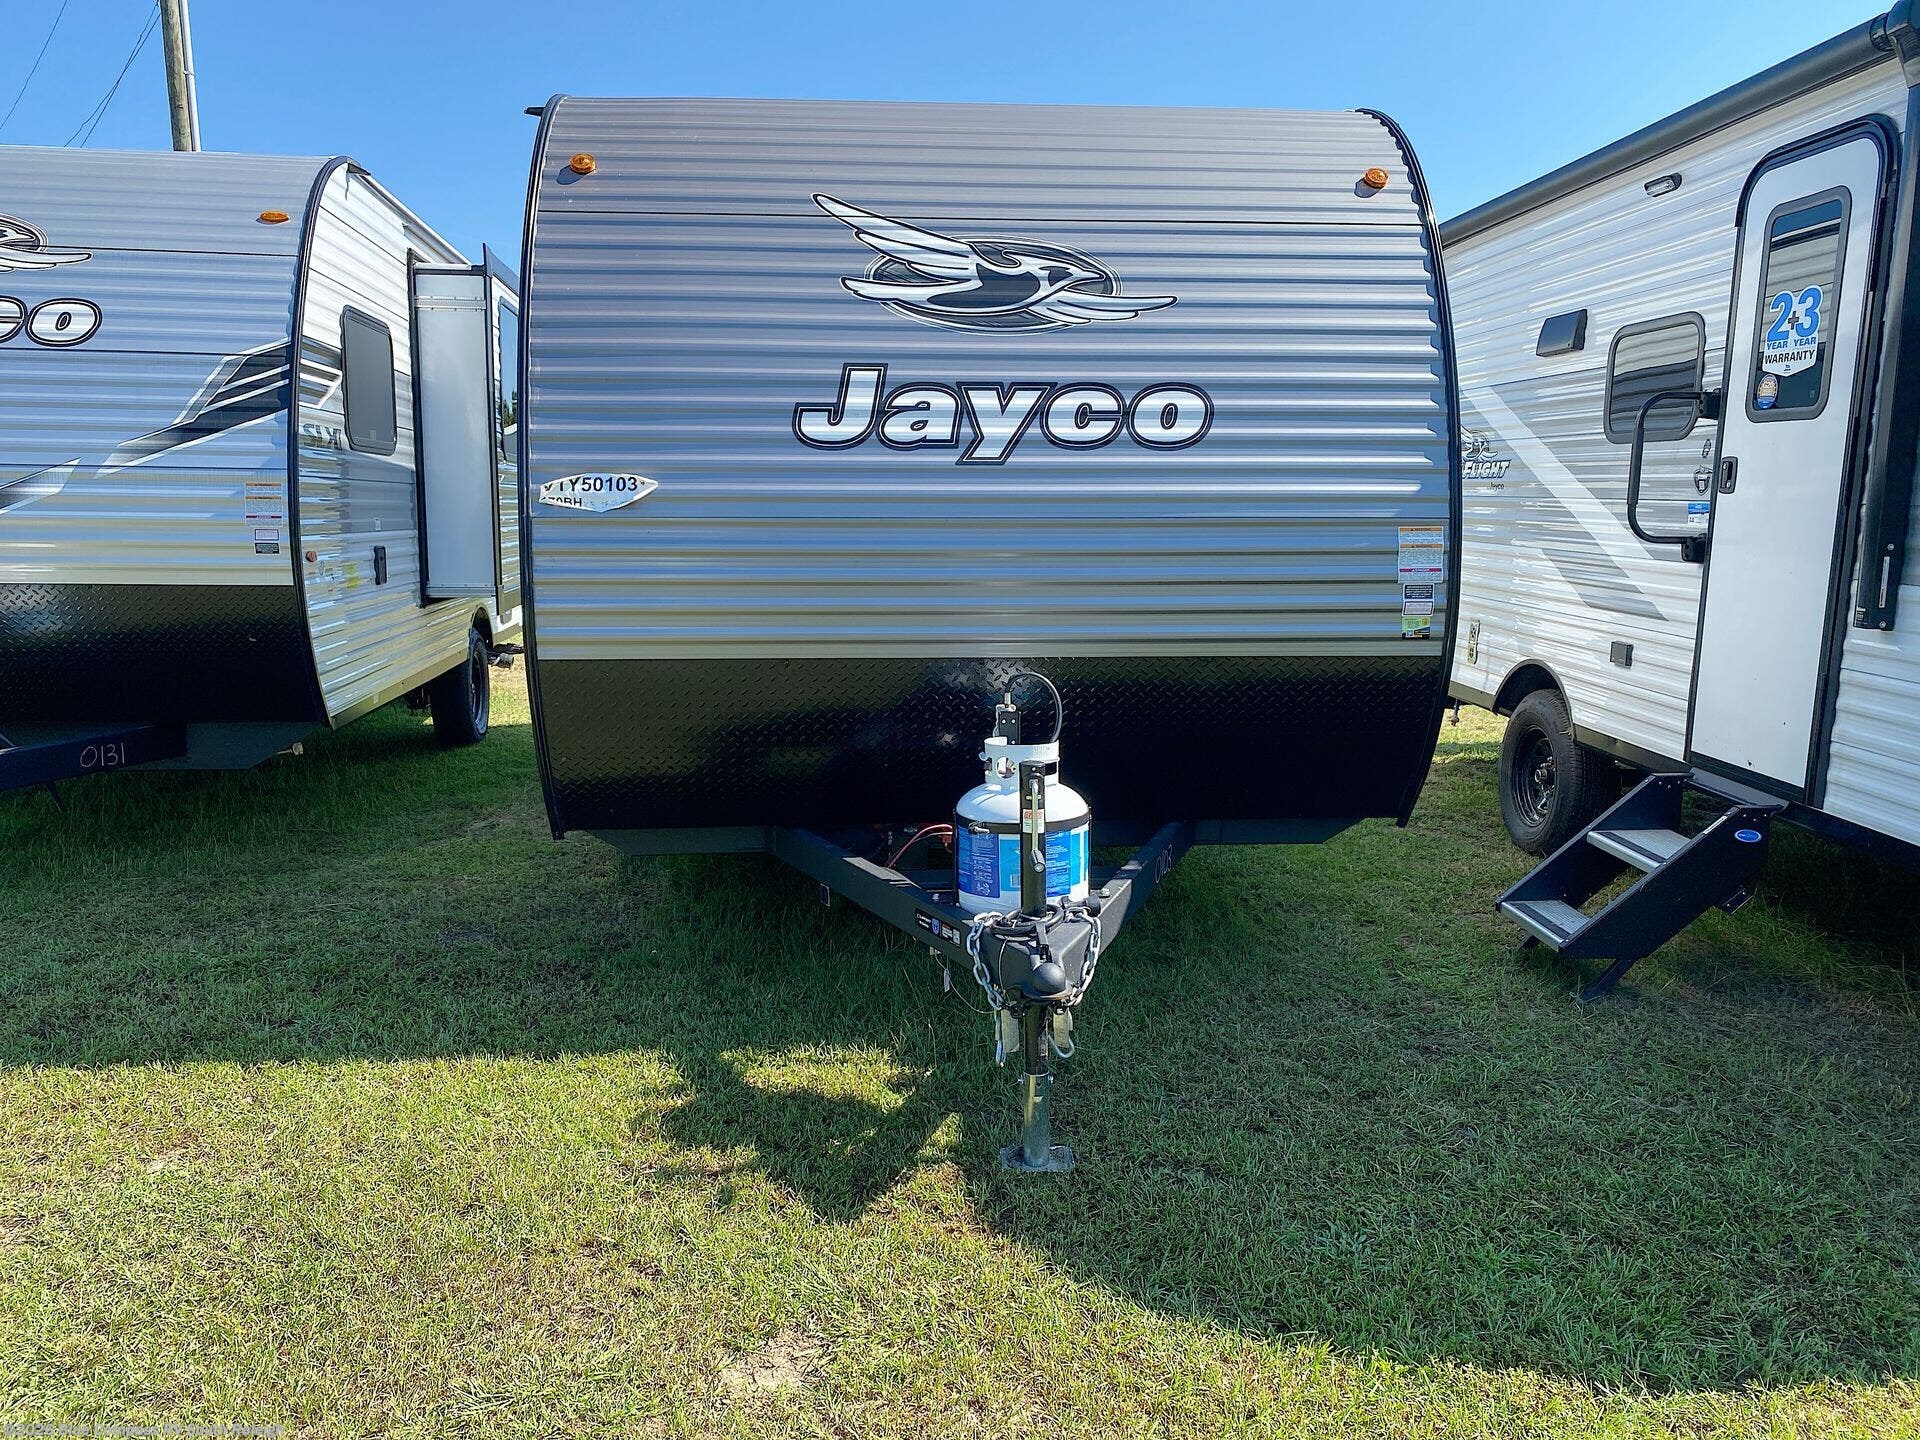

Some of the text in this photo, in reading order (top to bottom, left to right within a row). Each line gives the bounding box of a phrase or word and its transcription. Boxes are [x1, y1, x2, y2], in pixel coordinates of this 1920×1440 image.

[1767, 337, 1816, 350] YEAR YEAR
[1765, 350, 1815, 364] WARRANTY
[791, 363, 1214, 465] Jayco
[1463, 460, 1511, 479] FLIGHT
